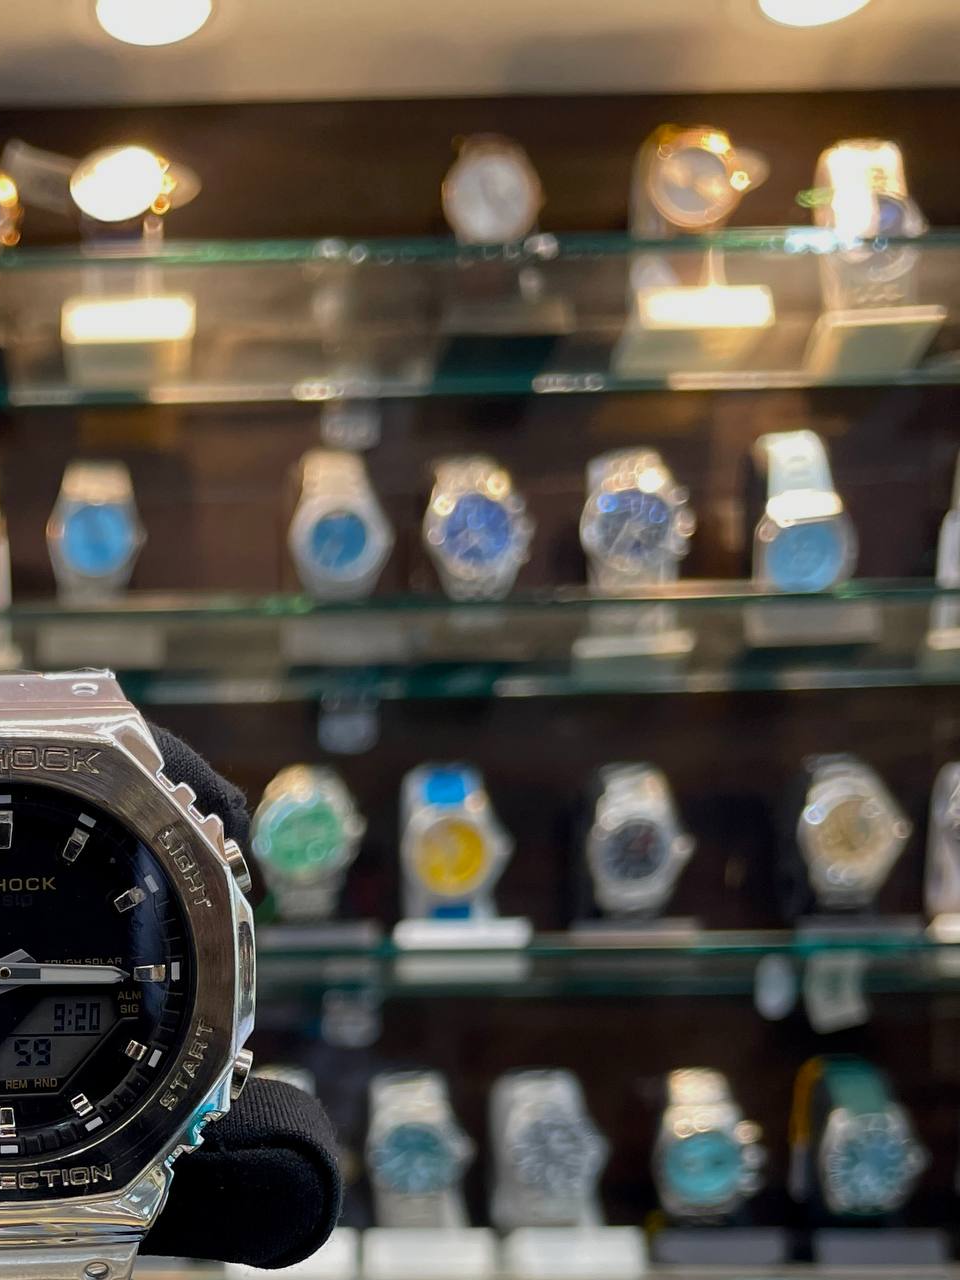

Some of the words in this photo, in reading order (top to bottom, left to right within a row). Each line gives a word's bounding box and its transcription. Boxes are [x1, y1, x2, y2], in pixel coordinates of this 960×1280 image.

[157, 824, 212, 907] LIGHT
[118, 991, 143, 1001] ALM
[119, 1003, 140, 1014] SIG
[53, 1002, 101, 1032] 9:20
[14, 1038, 52, 1067] 59
[159, 1018, 214, 1112] START
[5, 1079, 28, 1090] REM
[33, 1077, 58, 1088] HND
